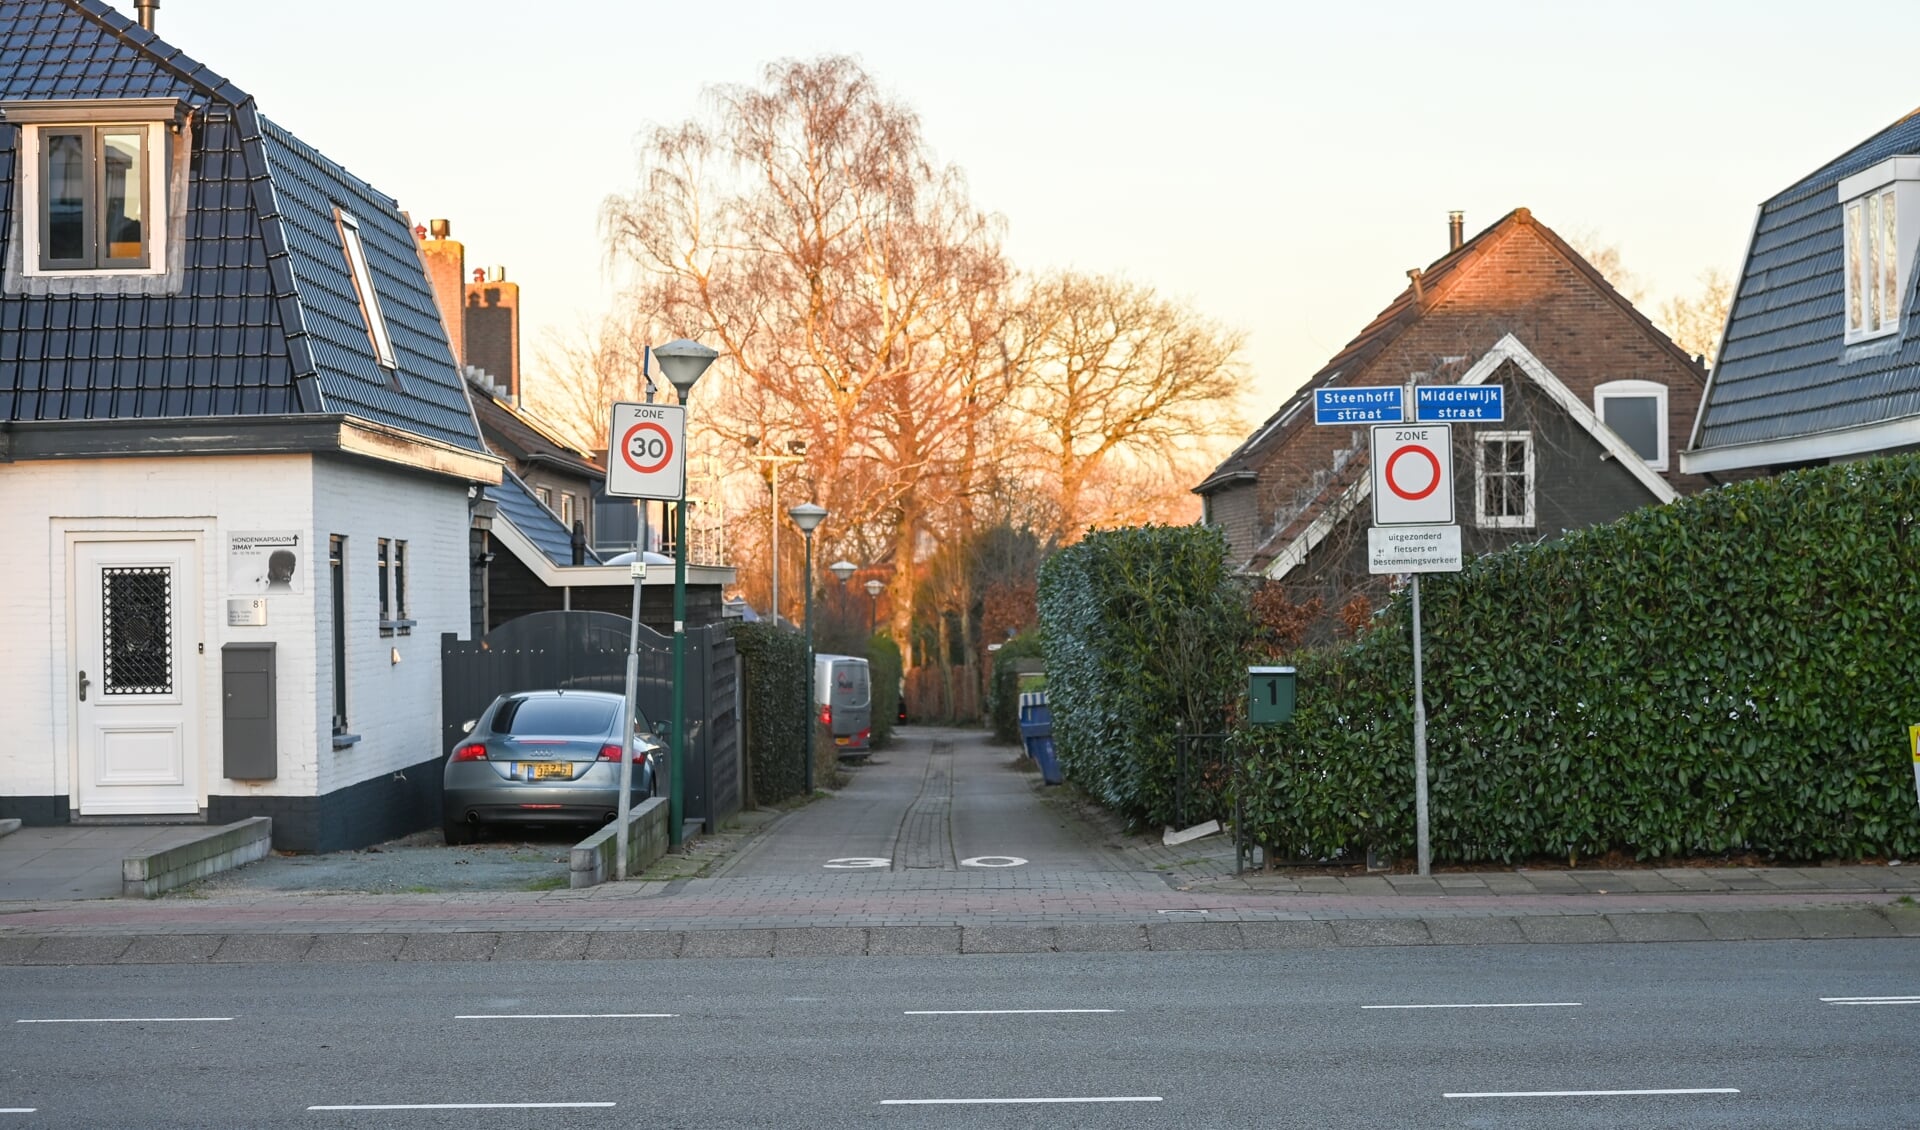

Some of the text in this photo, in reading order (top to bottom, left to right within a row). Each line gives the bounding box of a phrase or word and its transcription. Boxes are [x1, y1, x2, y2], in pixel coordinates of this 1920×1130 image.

[1324, 391, 1396, 404] Steenhoff
[1420, 390, 1498, 404] Middelwijk
[634, 409, 664, 419] ZONE
[1337, 409, 1382, 421] straat
[1438, 407, 1482, 418] straat
[1395, 431, 1429, 441] ZONE
[630, 437, 664, 459] 30
[1388, 533, 1442, 542] uitgezonderd
[1394, 545, 1426, 553] fietsers
[1373, 557, 1458, 566] bestemmingsverkeer
[1267, 680, 1276, 705] 1
[823, 856, 1029, 869] 30
